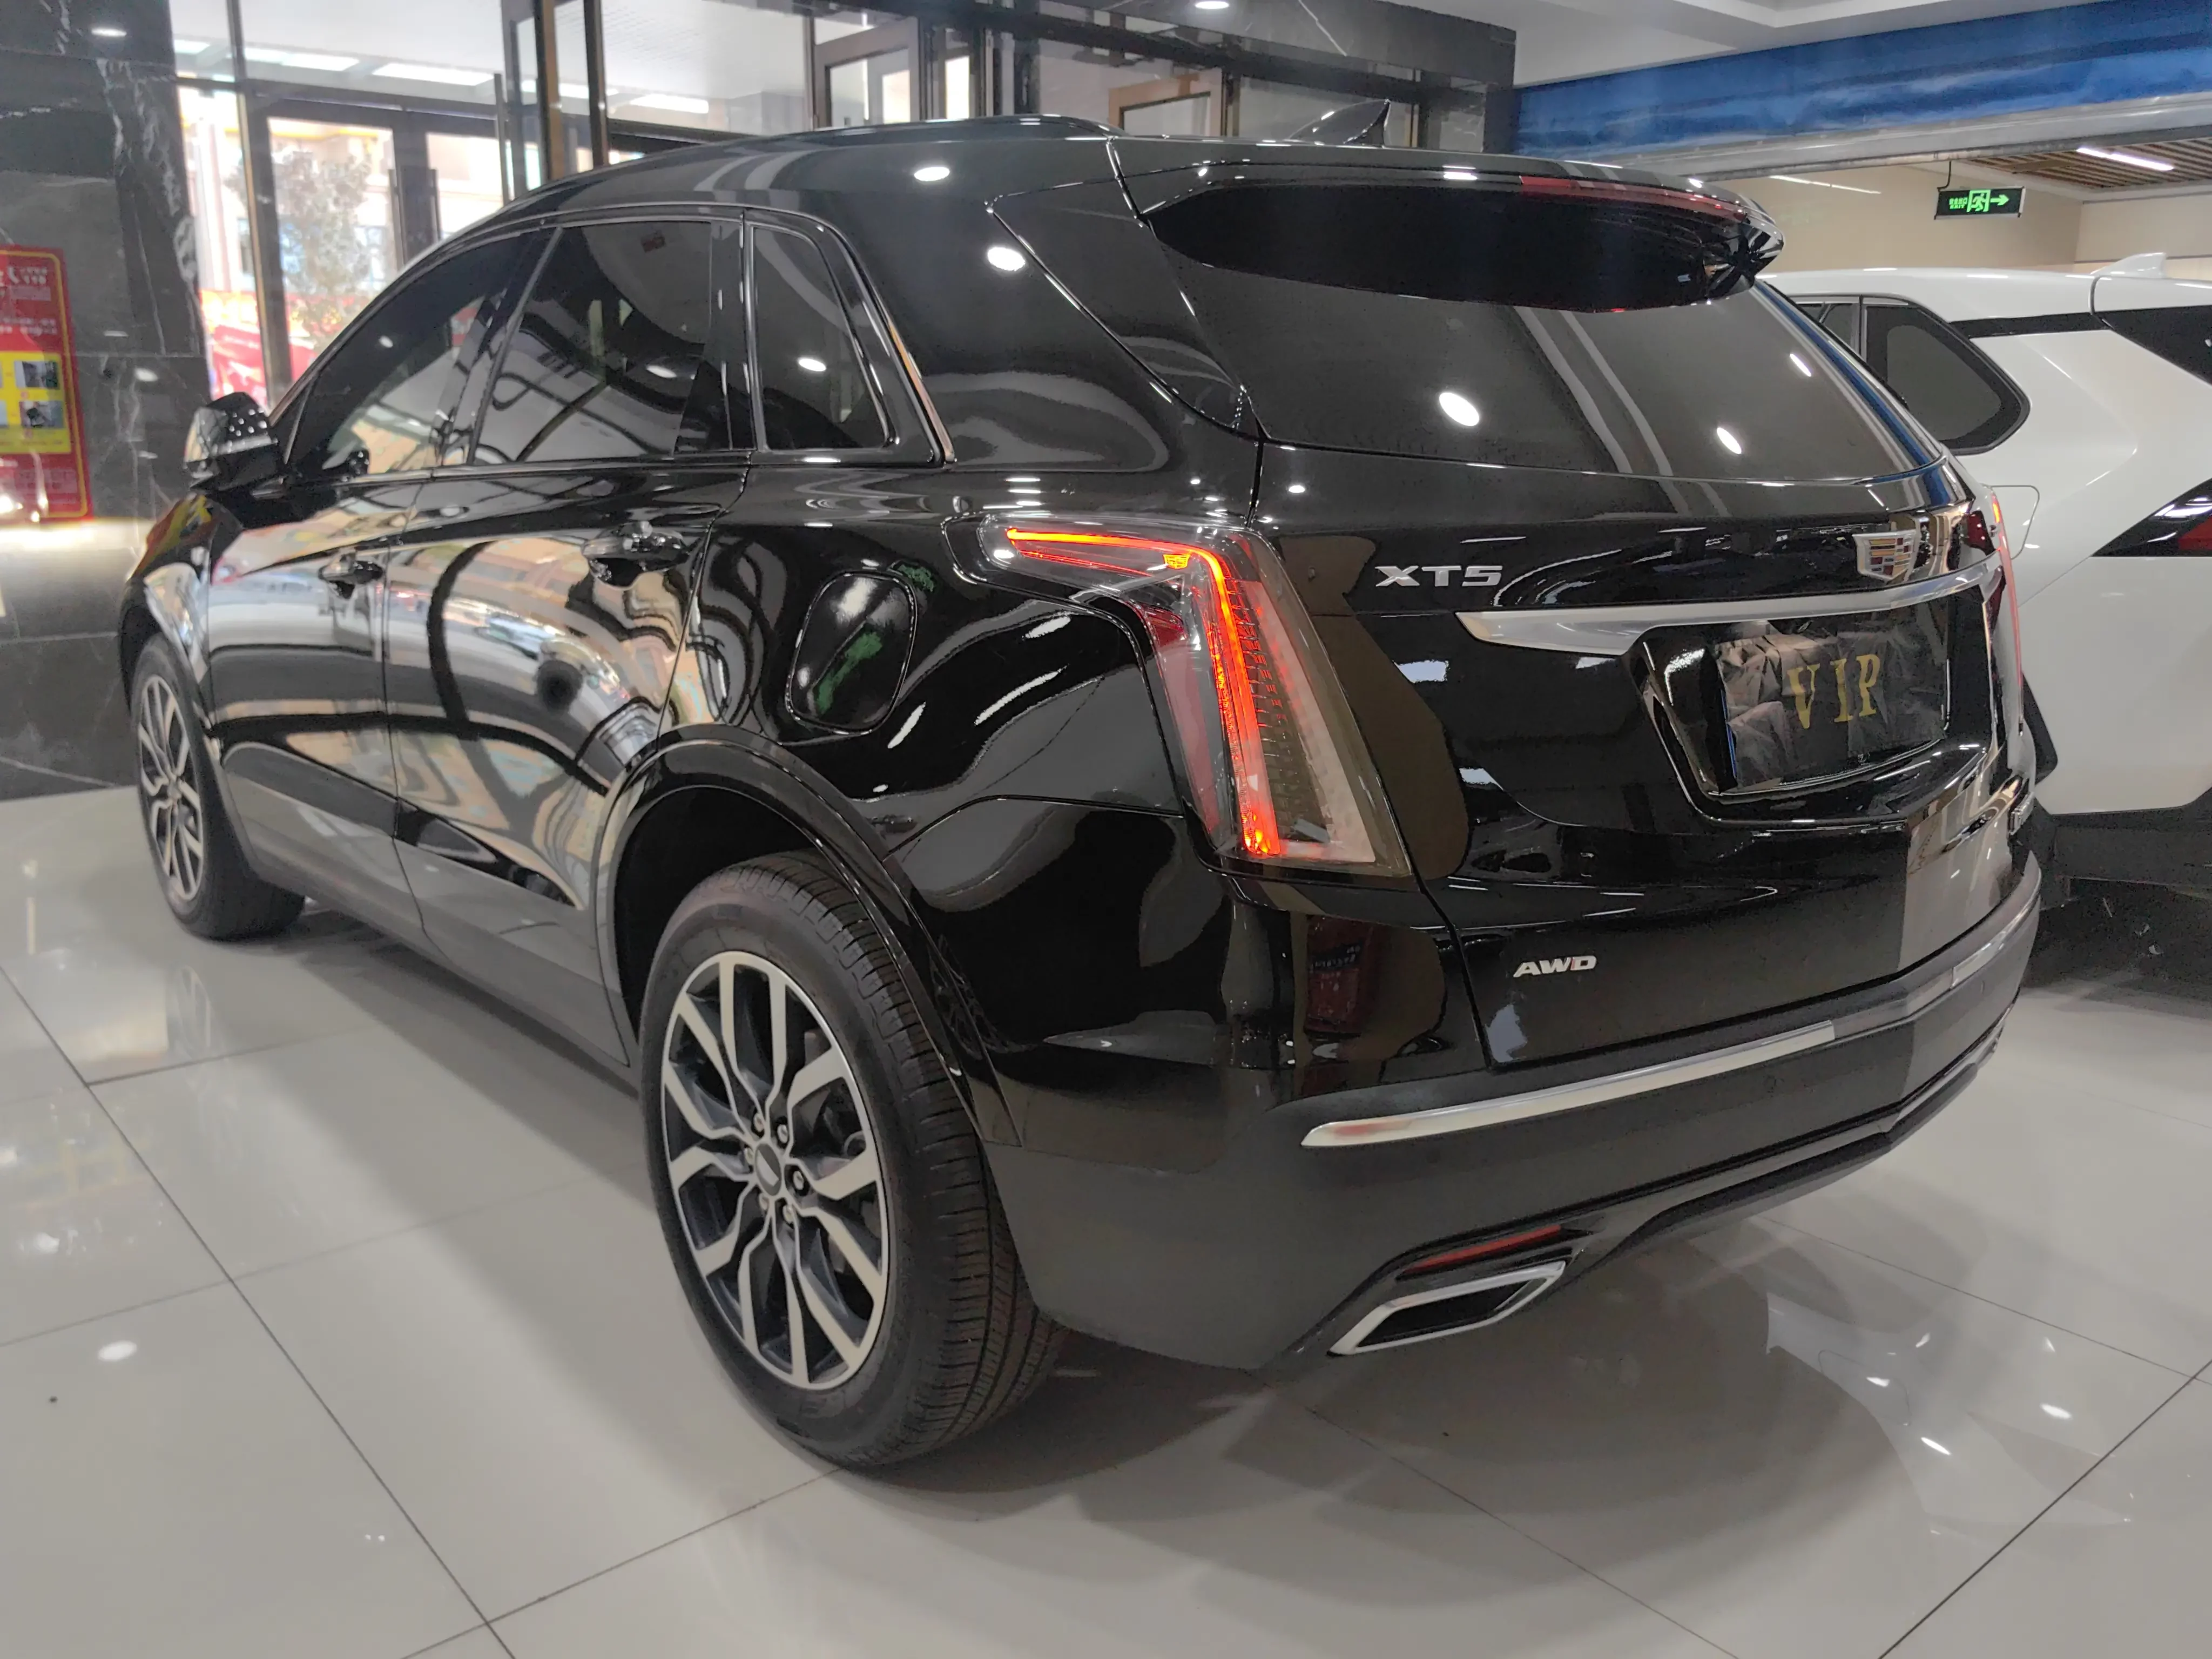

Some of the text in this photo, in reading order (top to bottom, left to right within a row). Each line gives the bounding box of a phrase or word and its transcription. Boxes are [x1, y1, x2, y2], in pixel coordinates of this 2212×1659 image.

[1375, 566, 1502, 586] XT5
[1786, 654, 1881, 729] VIP
[1513, 955, 1597, 977] AWD
